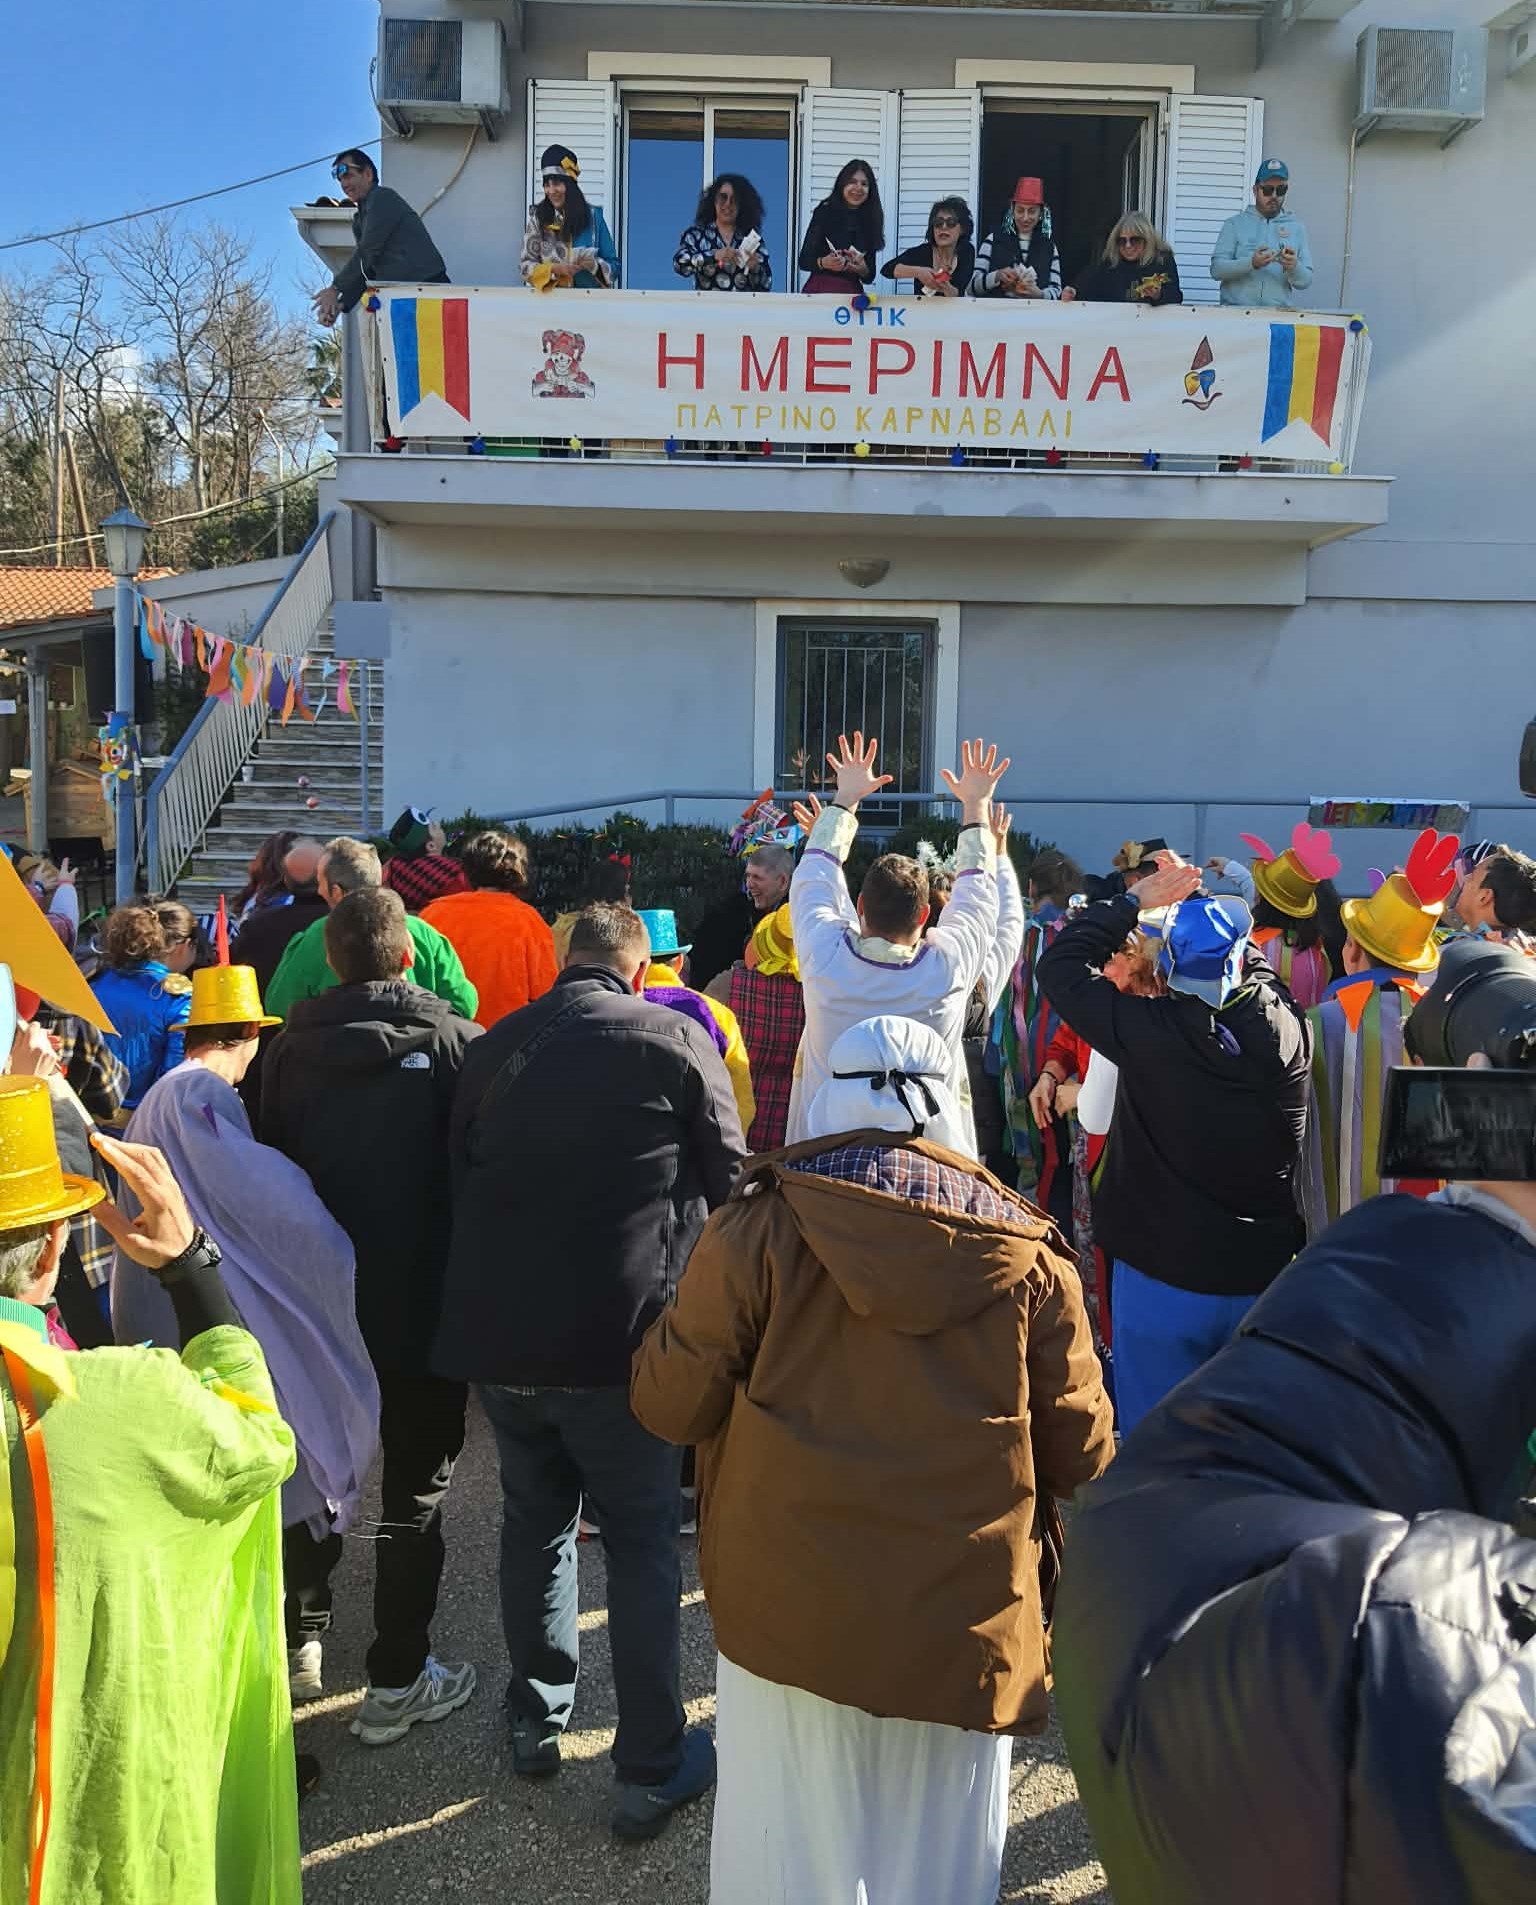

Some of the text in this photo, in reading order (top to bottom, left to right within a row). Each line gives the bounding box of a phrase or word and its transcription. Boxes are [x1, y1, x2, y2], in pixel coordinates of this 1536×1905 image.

[658, 332, 1131, 401] Η ΜΕΡΙΜΝΑ
[677, 404, 1072, 438] ΠΑΤΡΙΝΟ ΚΑΡΝΑΒΑΛΙ
